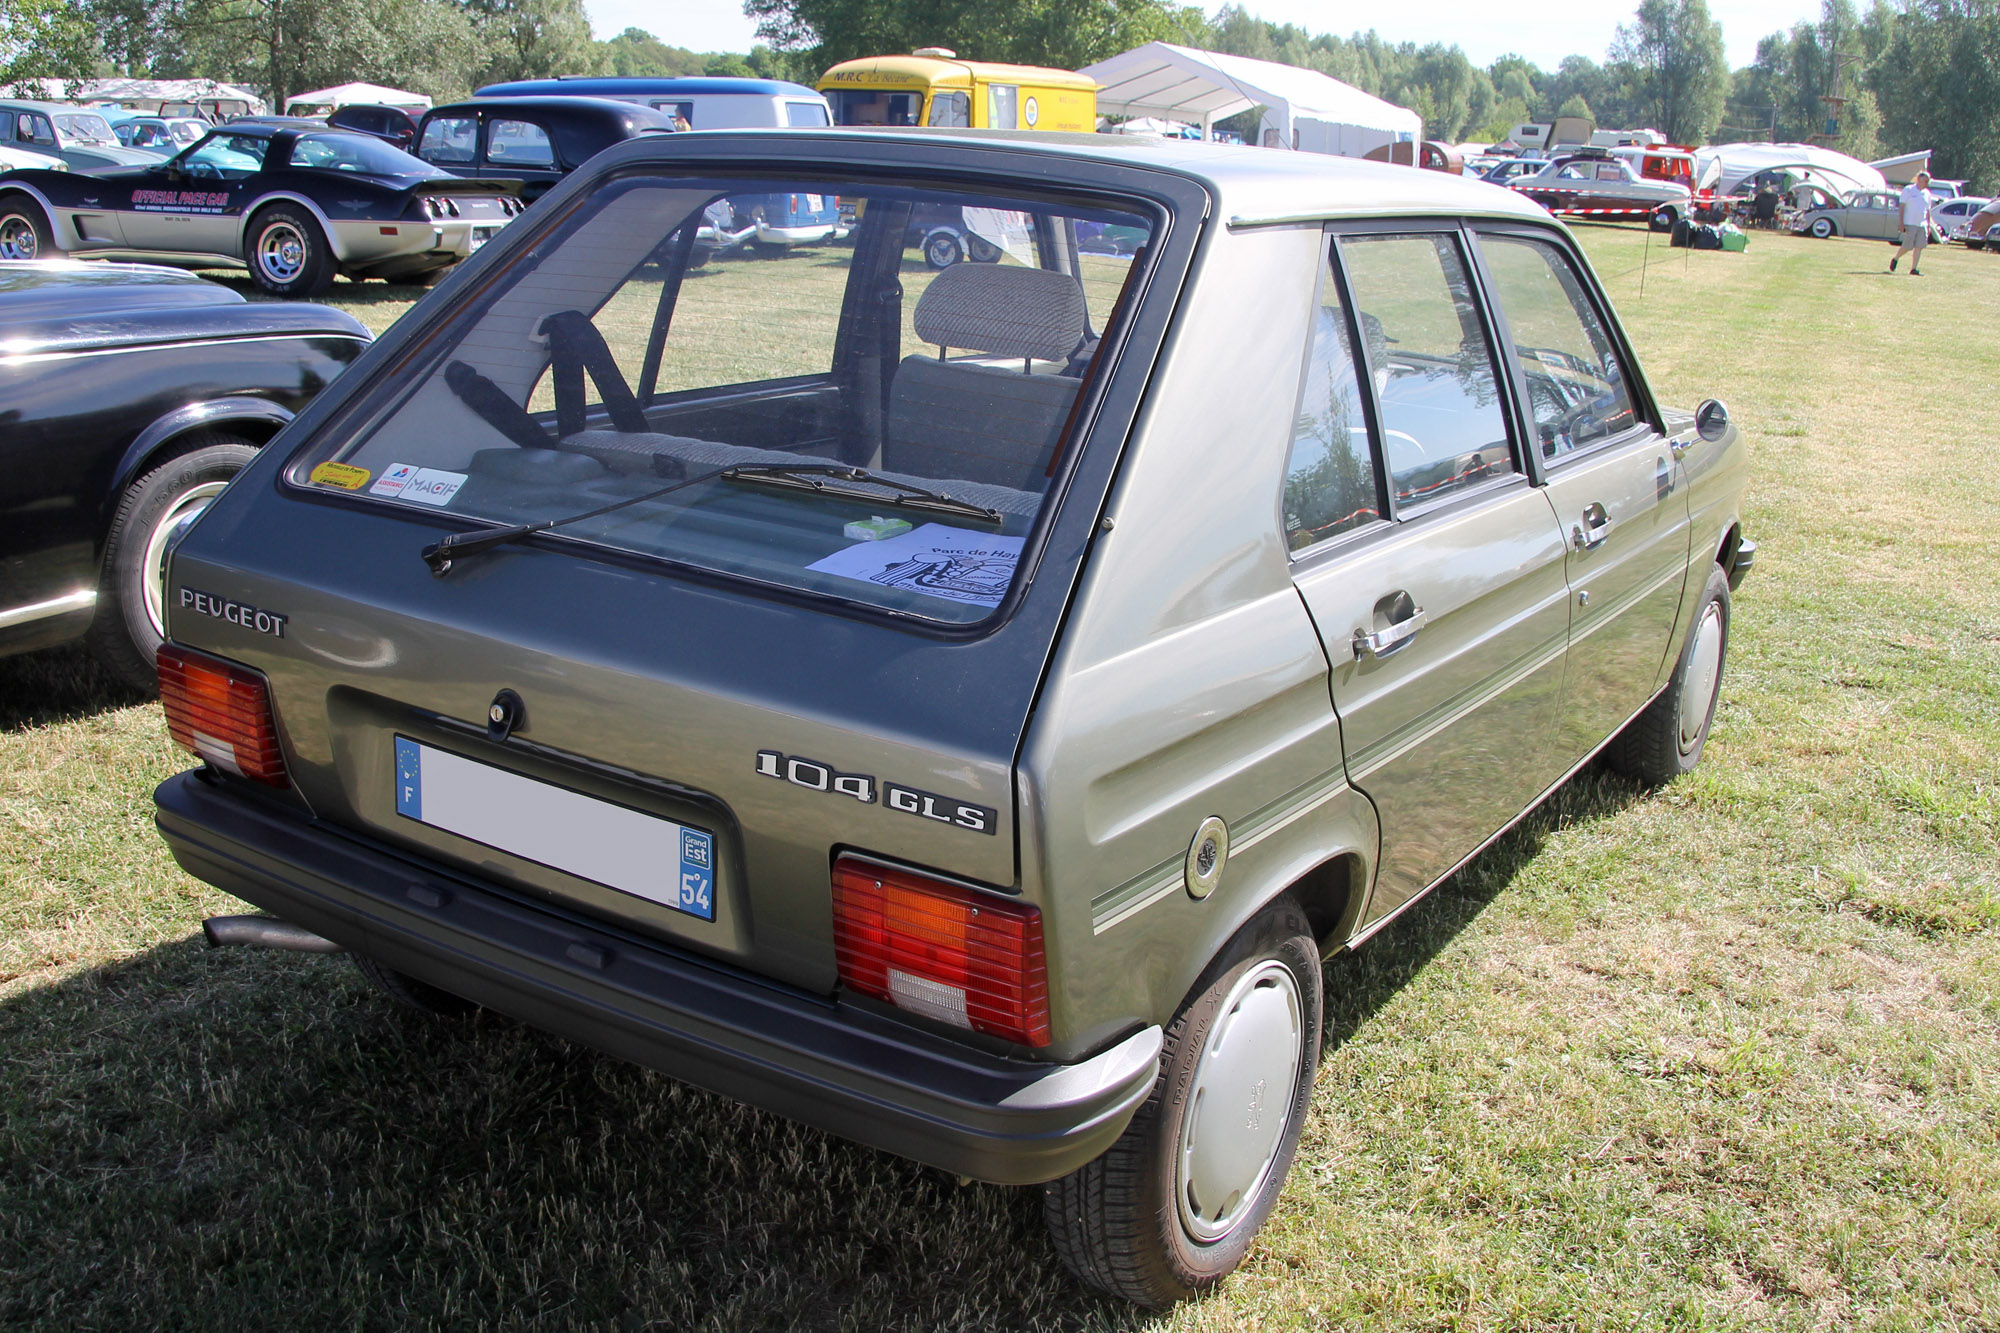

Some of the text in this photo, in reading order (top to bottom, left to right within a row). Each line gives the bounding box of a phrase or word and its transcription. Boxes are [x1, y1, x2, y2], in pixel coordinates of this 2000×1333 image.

[131, 190, 230, 206] OFFICIAL PACE CAR
[408, 479, 458, 497] MACIF
[931, 547, 964, 555] Parc
[180, 588, 284, 637] PEUGEOT
[405, 786, 414, 803] F
[757, 753, 985, 831] 104 GLS
[685, 836, 707, 848] Grand
[685, 843, 707, 862] Est
[681, 873, 710, 910] 54
